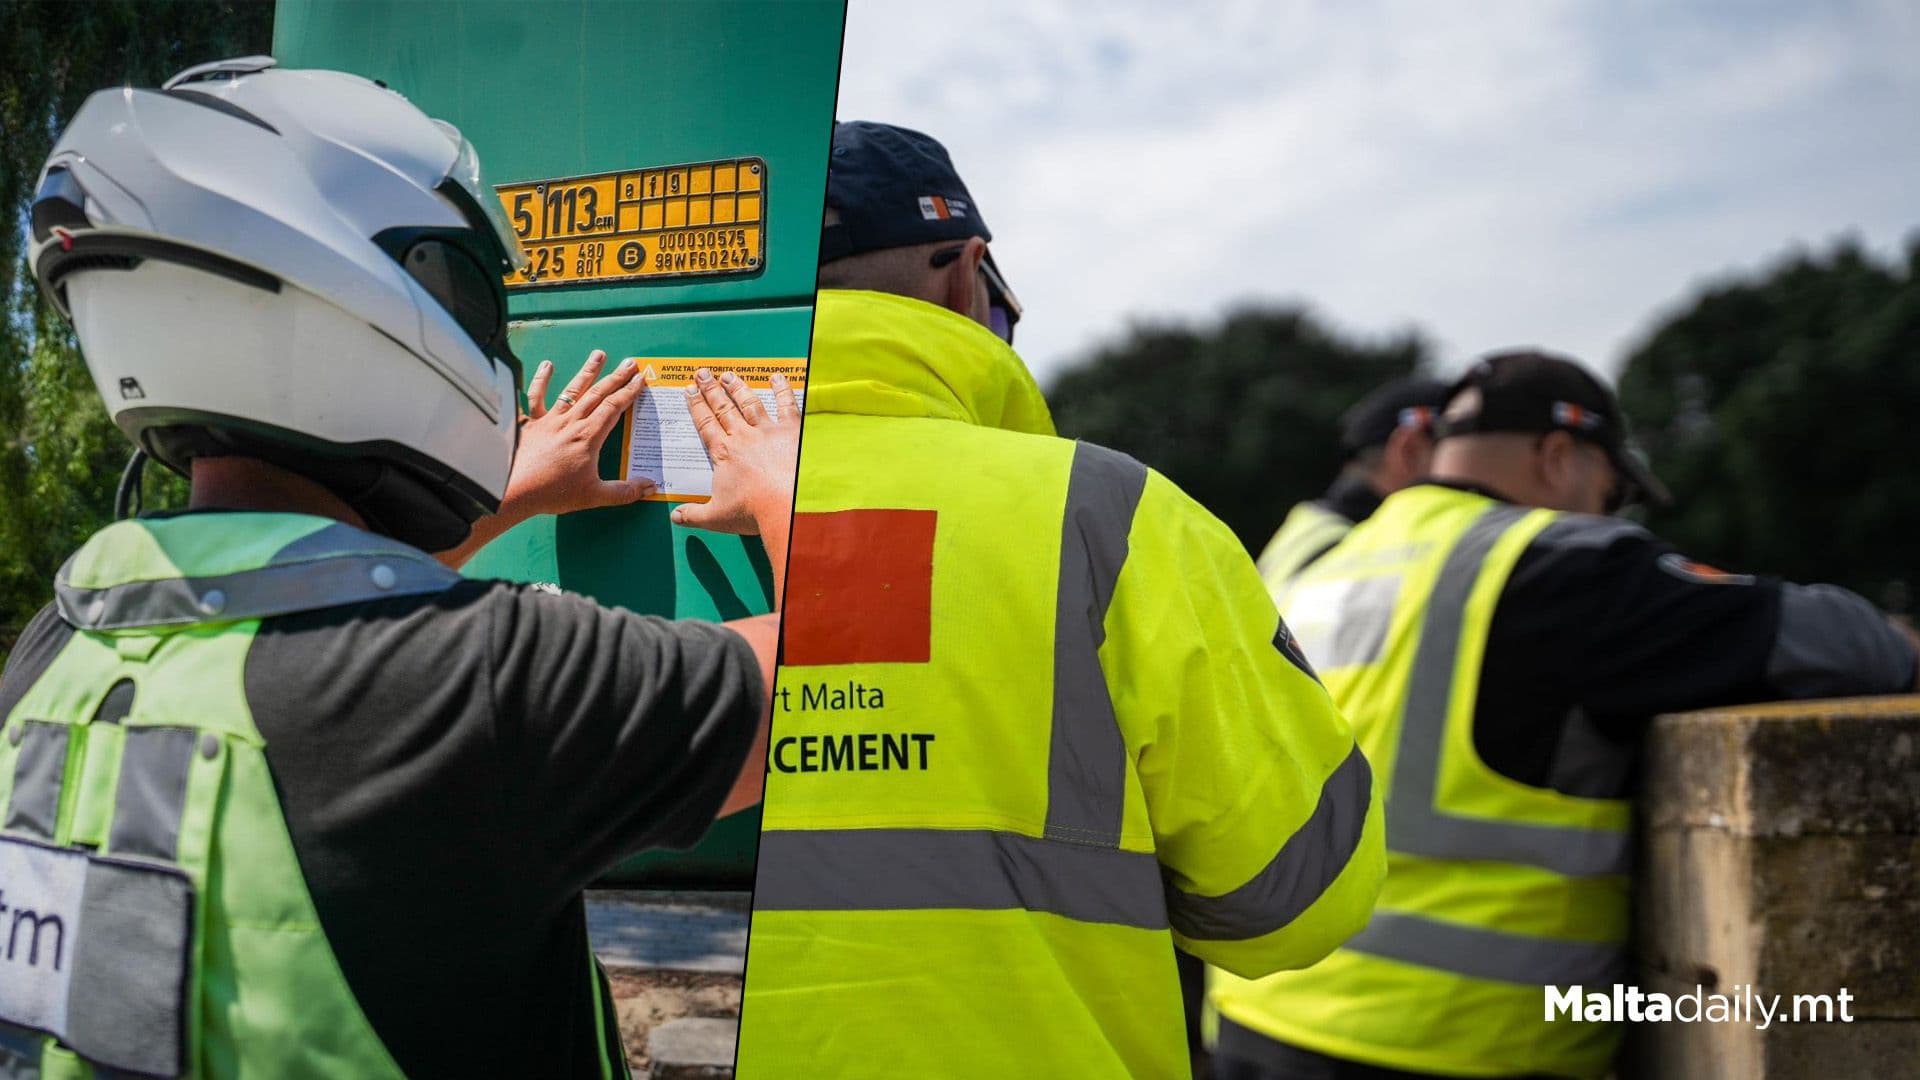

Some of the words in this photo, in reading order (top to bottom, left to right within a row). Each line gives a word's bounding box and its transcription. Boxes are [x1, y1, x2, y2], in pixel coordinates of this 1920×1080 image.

[671, 173, 680, 193] g
[513, 193, 532, 236] 5
[659, 229, 746, 250] 000030575
[576, 258, 602, 275] 801
[623, 249, 639, 266] B
[684, 365, 735, 373] TAL-TORITA'
[801, 681, 884, 711] Malta
[767, 733, 935, 773] CEMENT
